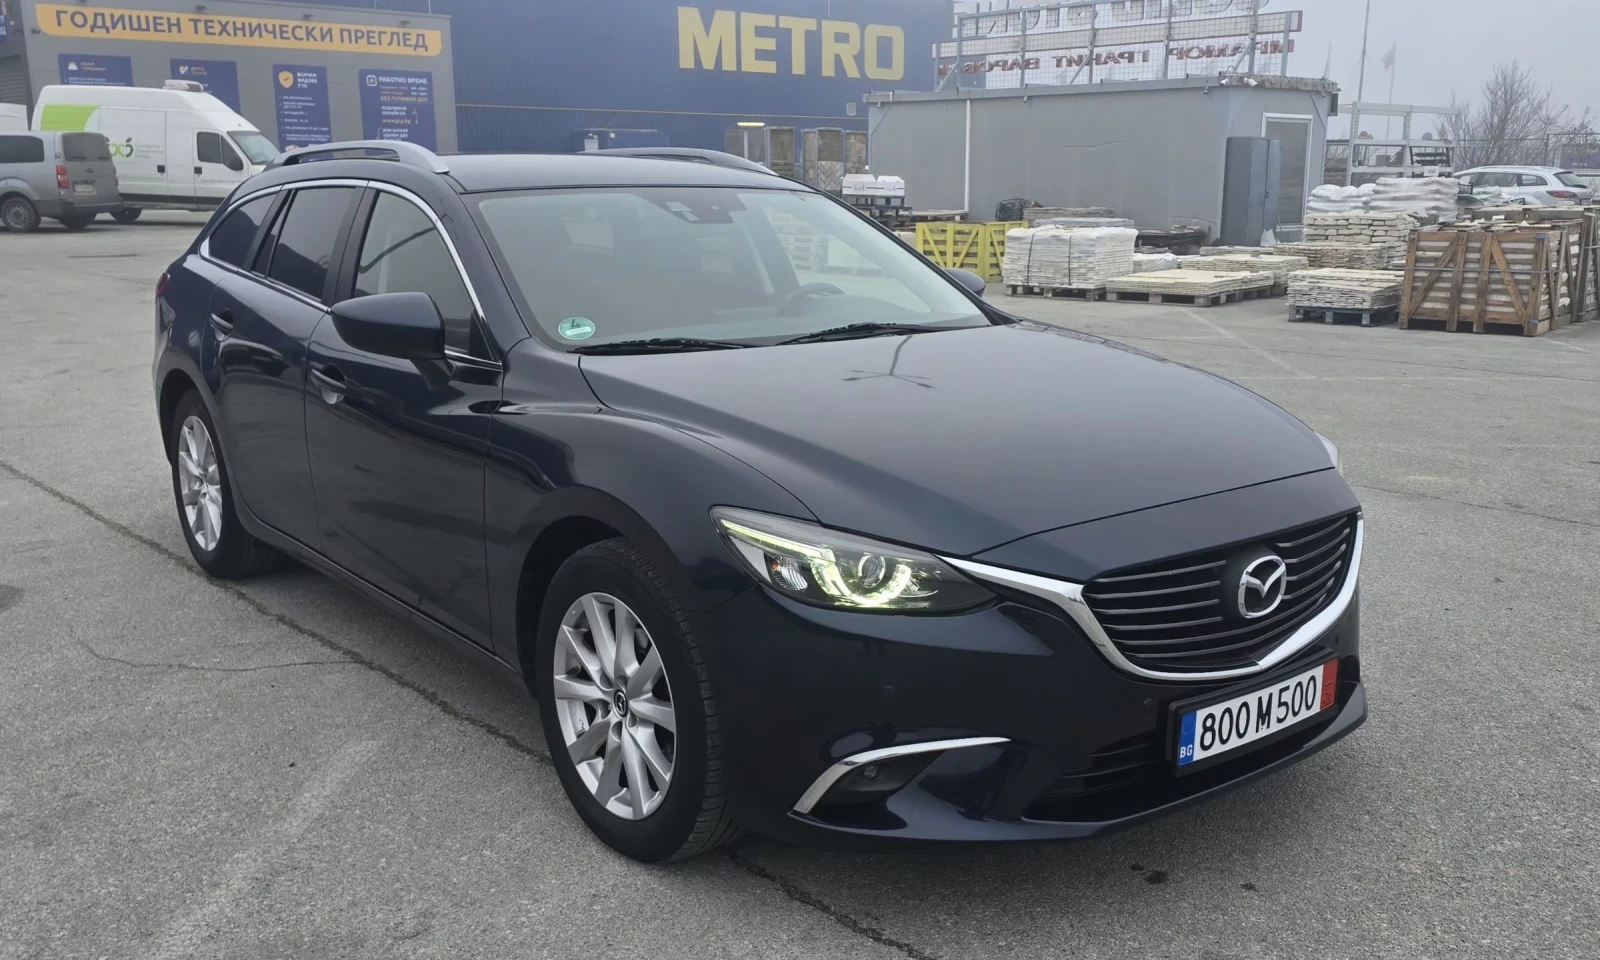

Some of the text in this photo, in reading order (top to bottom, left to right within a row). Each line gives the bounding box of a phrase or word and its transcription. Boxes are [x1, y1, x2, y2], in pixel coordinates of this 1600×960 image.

[55, 9, 429, 52] ГОДИШЕН ТЕХНИЧЕСКИ ПРЕГЛЕД
[677, 6, 905, 81] METRO
[1179, 744, 1194, 759] BG
